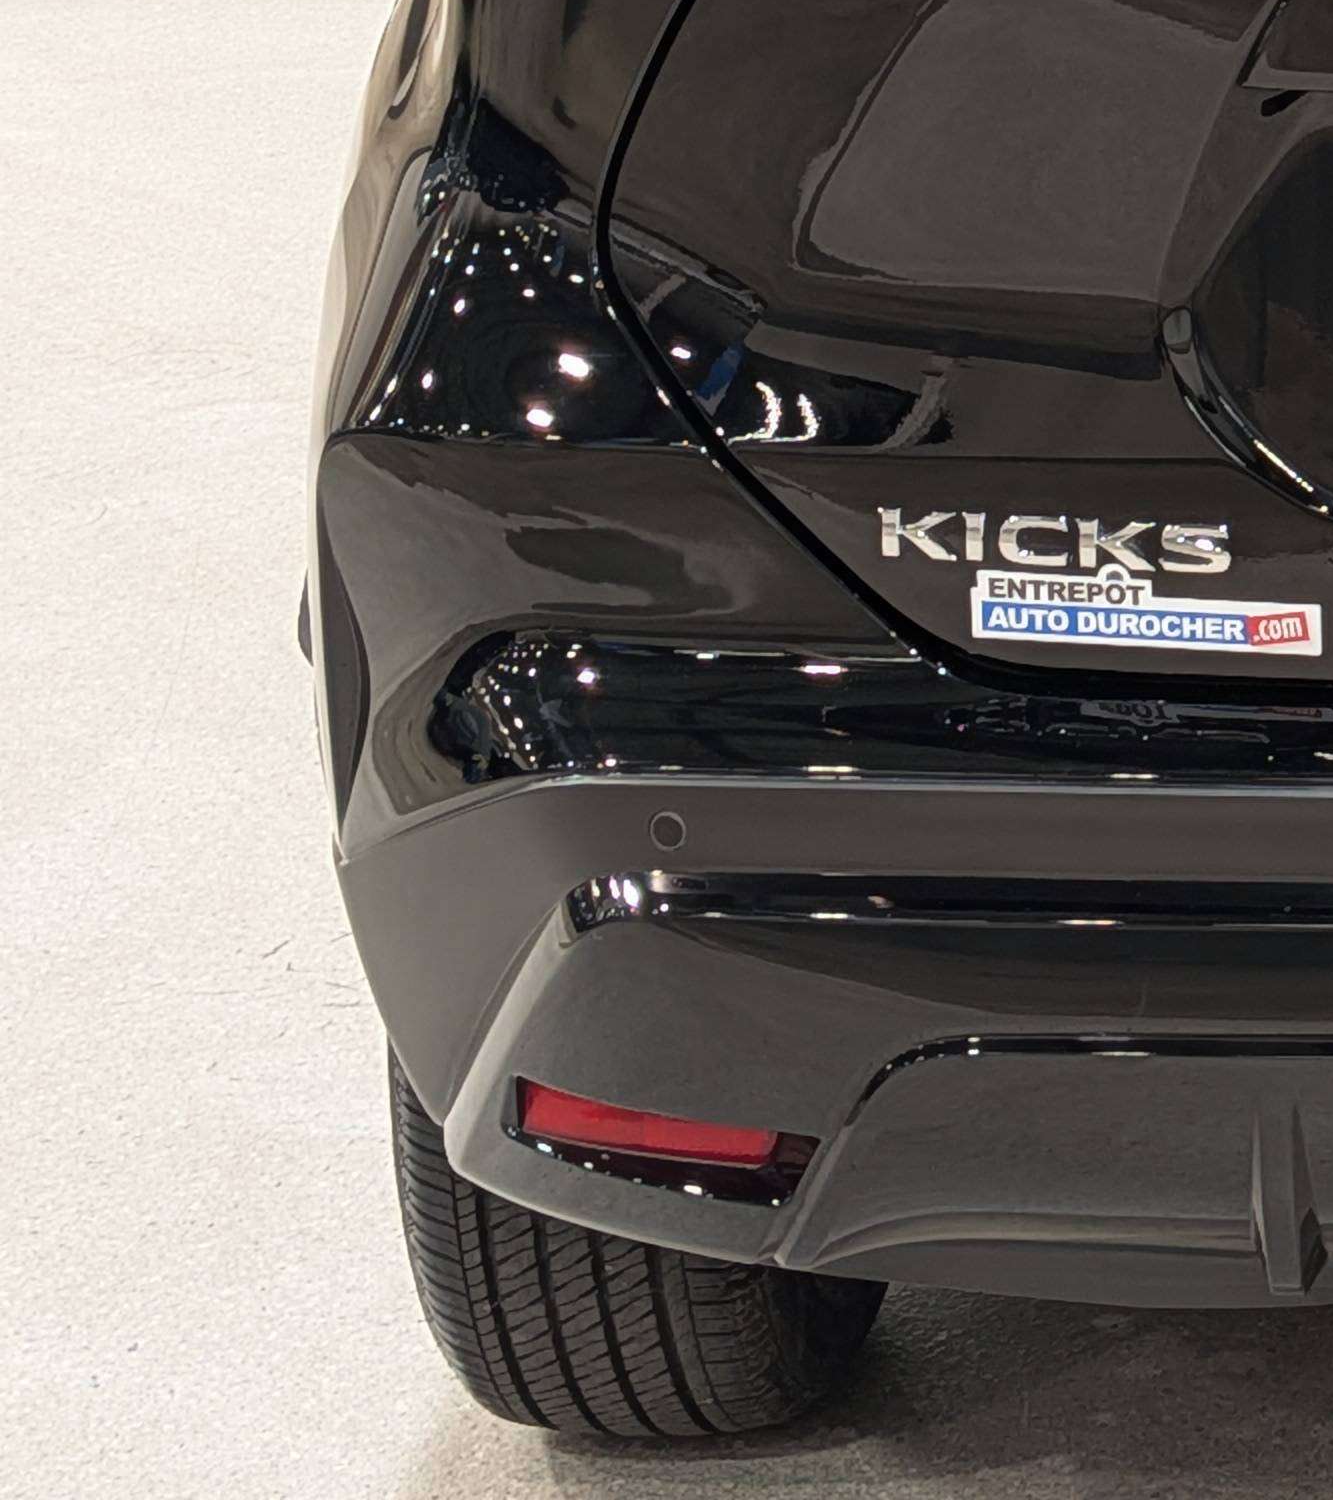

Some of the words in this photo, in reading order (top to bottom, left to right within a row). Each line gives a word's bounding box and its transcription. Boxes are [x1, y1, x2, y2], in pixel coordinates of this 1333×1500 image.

[878, 506, 1232, 573] KICKS
[987, 606, 1070, 632] AUTO
[1077, 611, 1246, 641] DUROCHER
[1253, 617, 1303, 642] .com
